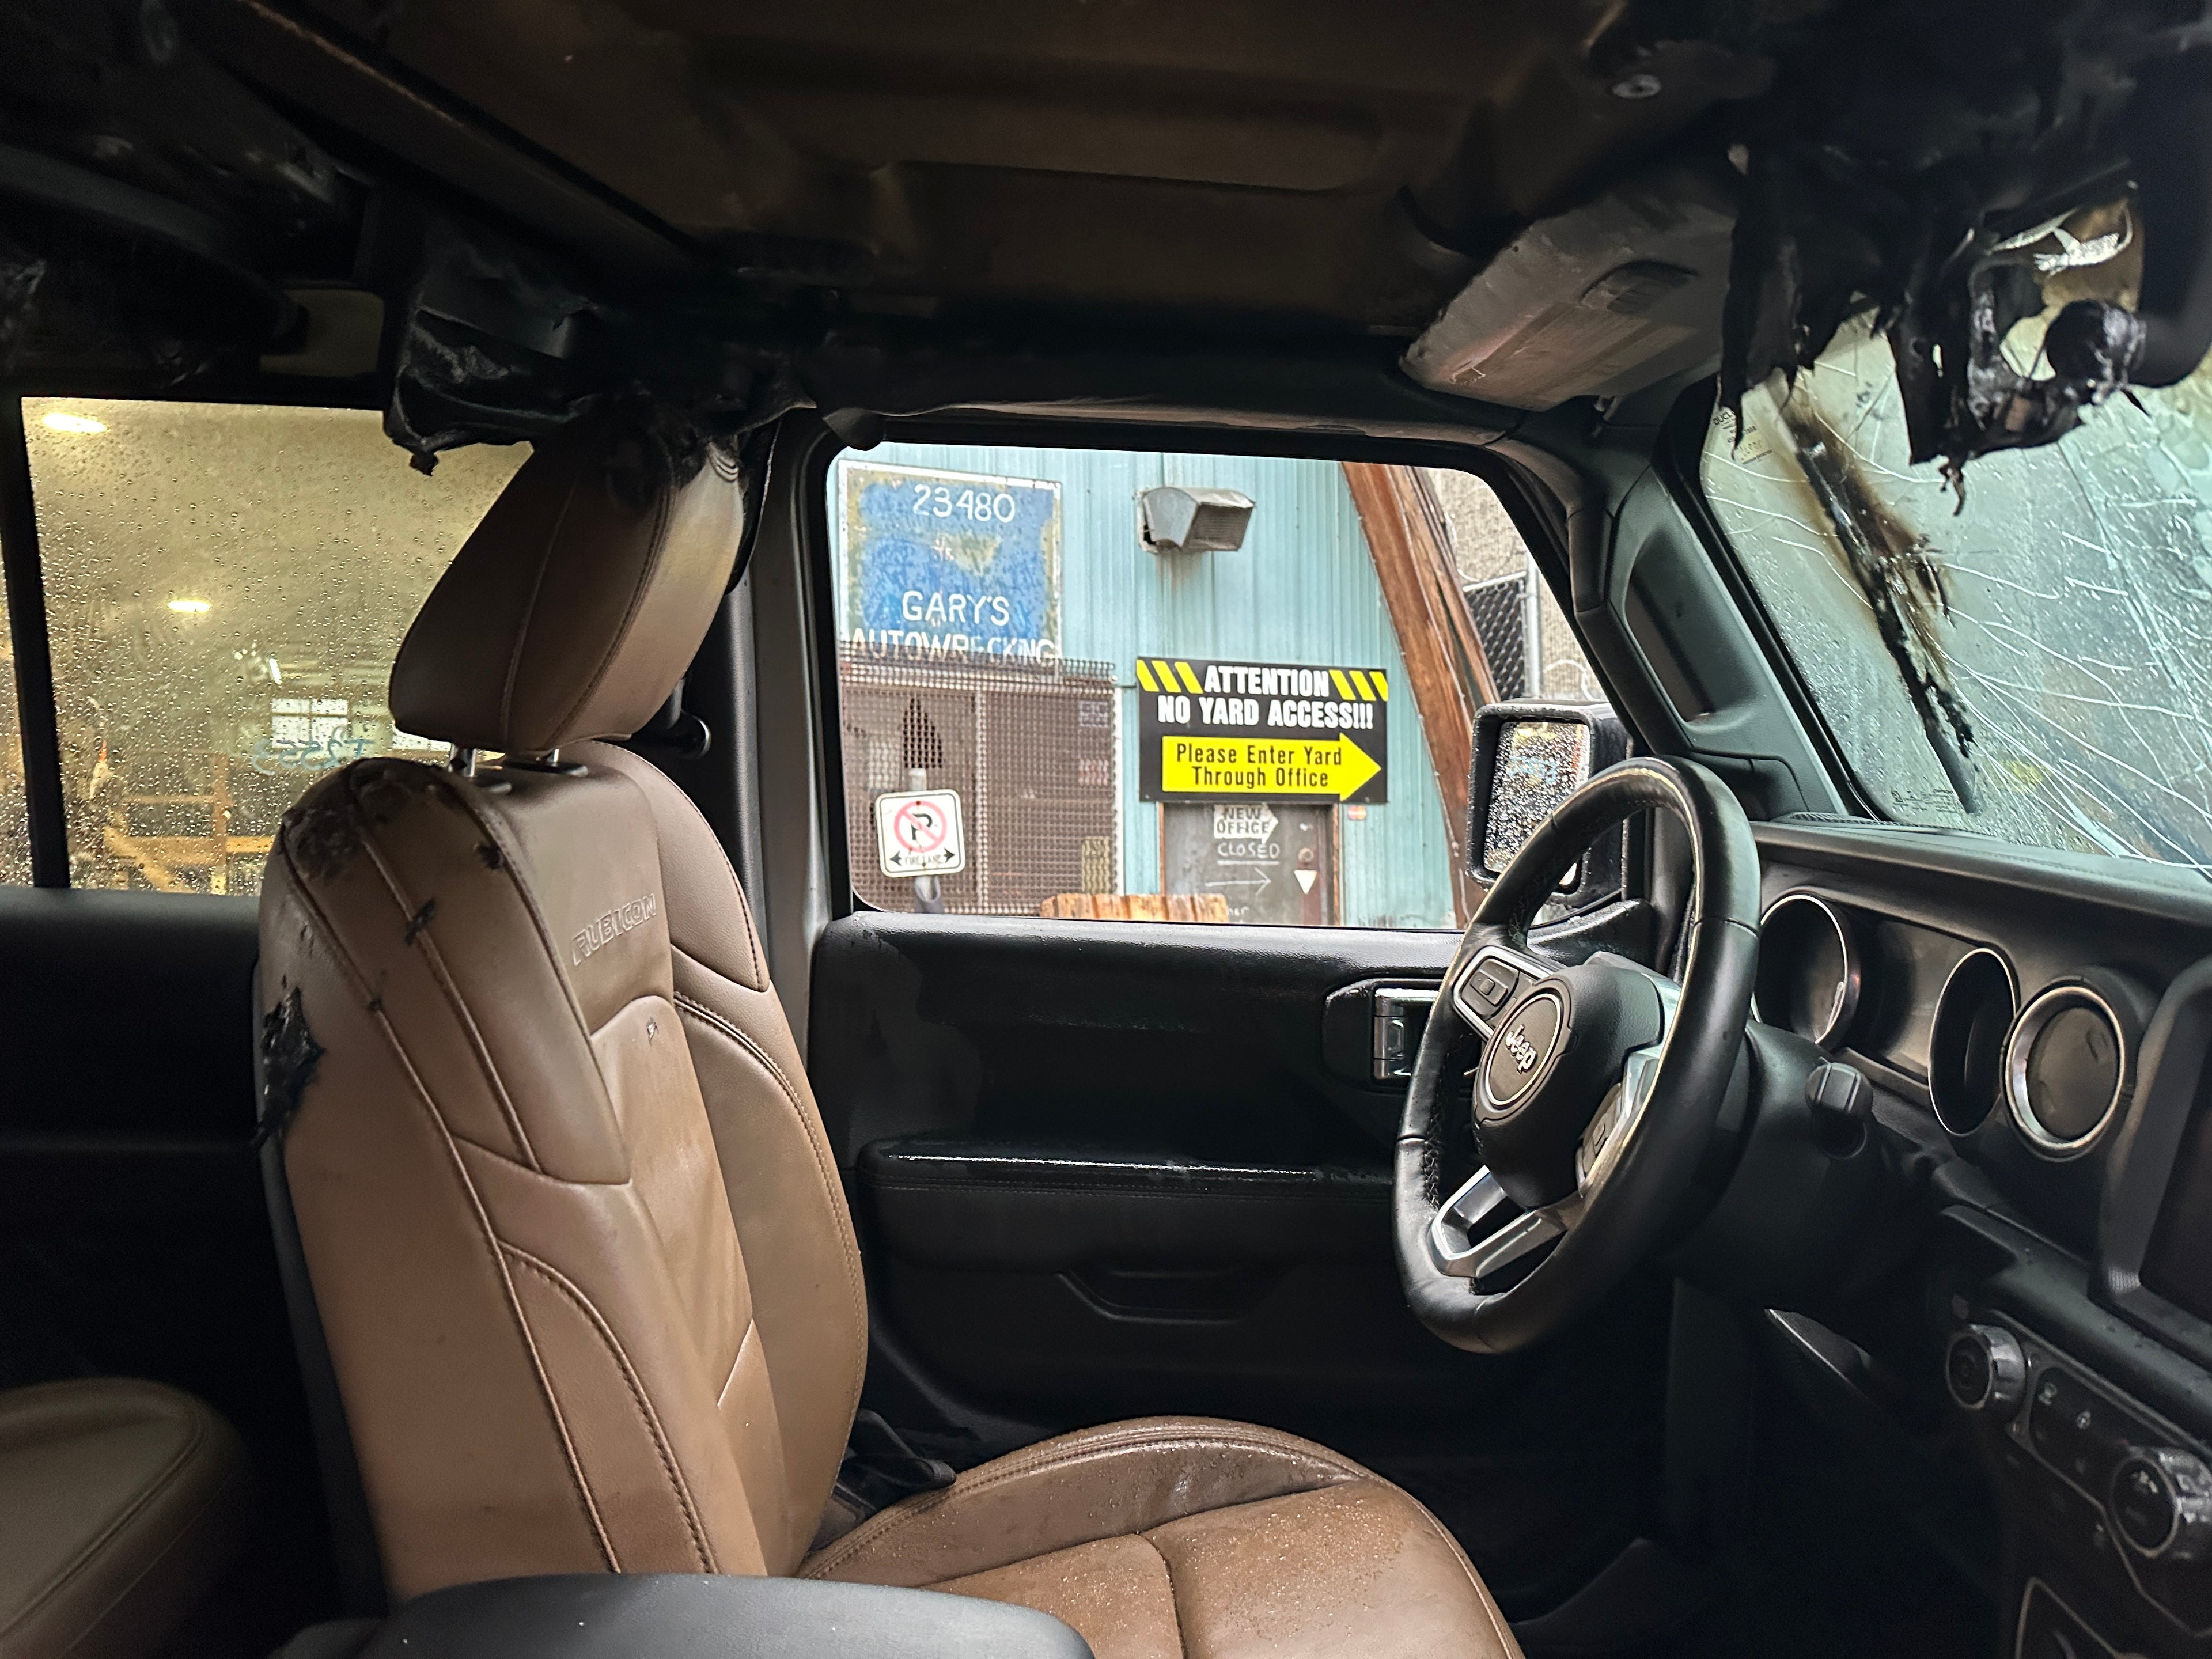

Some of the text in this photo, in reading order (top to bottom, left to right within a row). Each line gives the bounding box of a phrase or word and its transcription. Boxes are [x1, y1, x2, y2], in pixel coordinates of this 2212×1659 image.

[912, 484, 1016, 523] 23480
[1204, 665, 1330, 698] ATTENTION
[1157, 695, 1374, 730] NO YARD ACCESS!!!
[1176, 743, 1342, 766] Please Enter Yard
[1192, 766, 1329, 790] Through Office
[1223, 807, 1262, 820] NEW
[1216, 821, 1269, 835] OFFICE
[1217, 843, 1281, 859] CLOSED
[1506, 1024, 1536, 1073] Jeep
